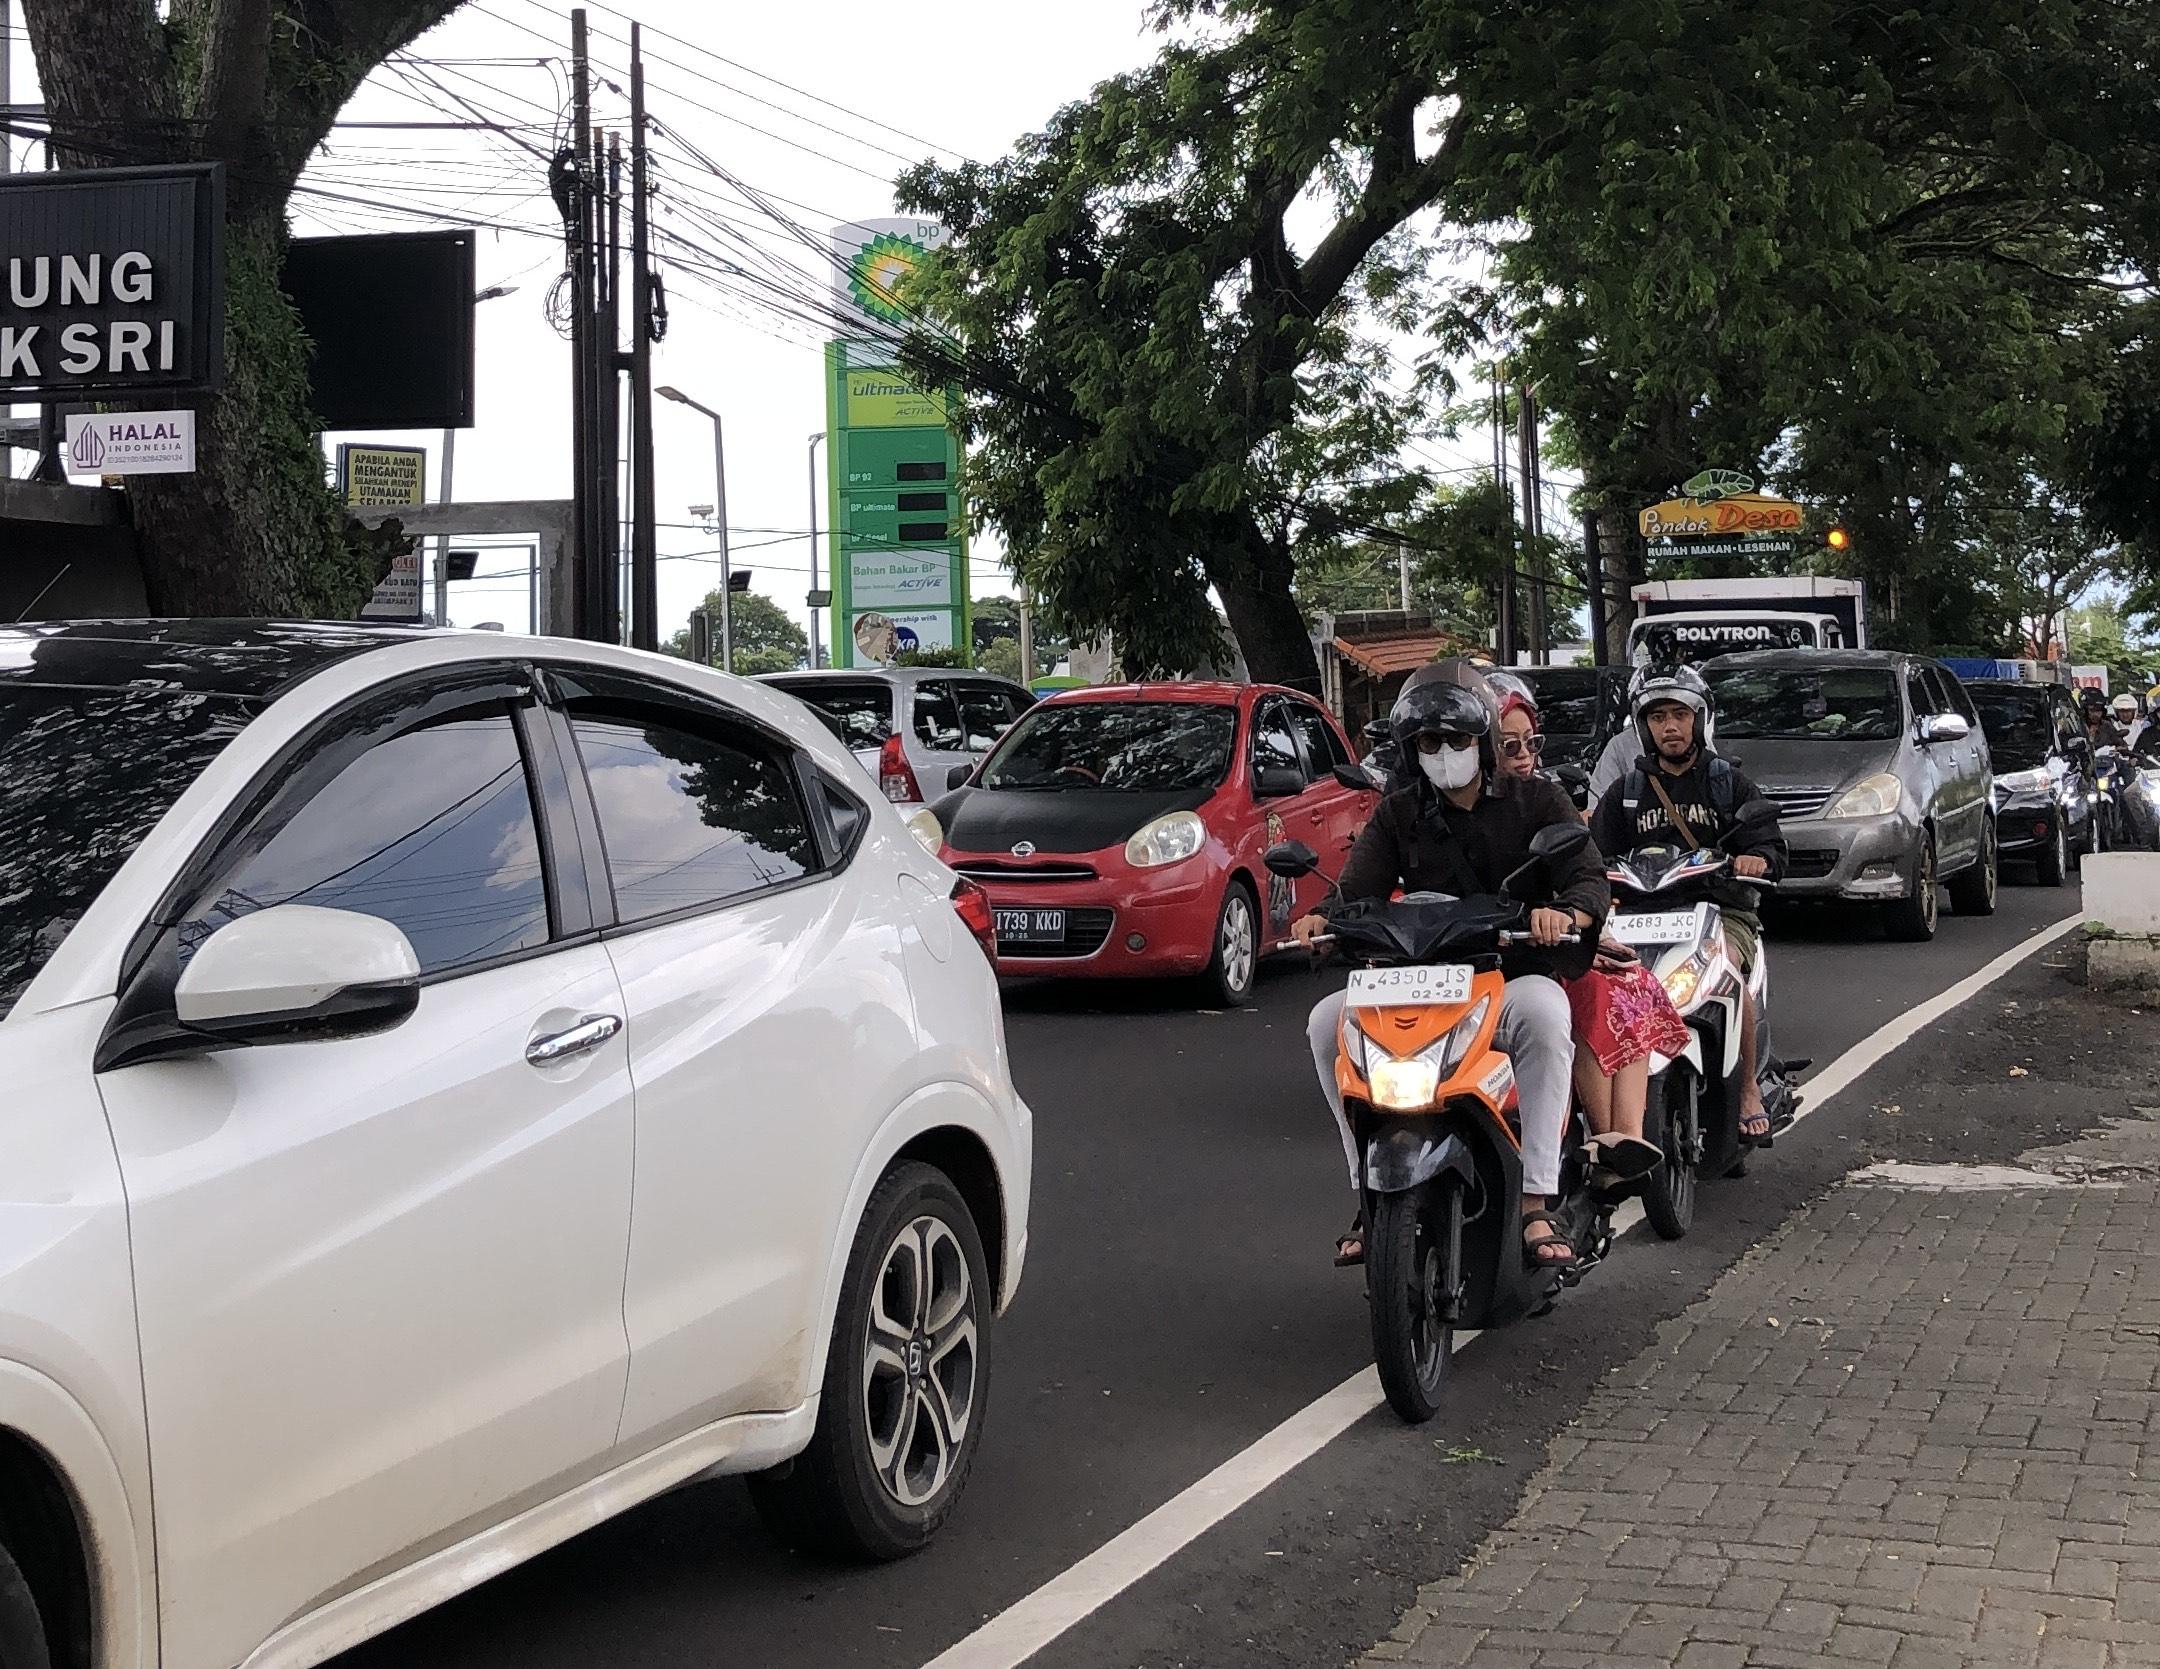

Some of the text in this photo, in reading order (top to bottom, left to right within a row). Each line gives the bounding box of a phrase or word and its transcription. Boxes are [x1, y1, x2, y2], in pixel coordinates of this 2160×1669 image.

[917, 222, 939, 241] bp
[10, 251, 153, 308] UNG
[0, 321, 174, 377] K SRI
[109, 423, 181, 441] HALAL
[108, 443, 182, 452] INDONESIA
[354, 454, 417, 467] APABILA ANDA
[354, 465, 417, 478] MENGANTUK
[360, 487, 411, 498] UTAMAKAN
[850, 504, 896, 512] BP ultimate
[1643, 502, 1799, 534] Pondok Desa
[1647, 547, 1688, 557] RUMAH
[853, 563, 936, 576] Bahan Bakar BP
[898, 579, 943, 589] ACTIVE
[921, 614, 938, 622] with
[1790, 627, 1801, 643] 6
[996, 912, 1061, 930] 1739 KKD
[1627, 916, 1661, 929] 4683
[1675, 915, 1694, 927] KC
[1350, 968, 1466, 988] N 4350 IS
[1487, 1063, 1510, 1087] HONDA
